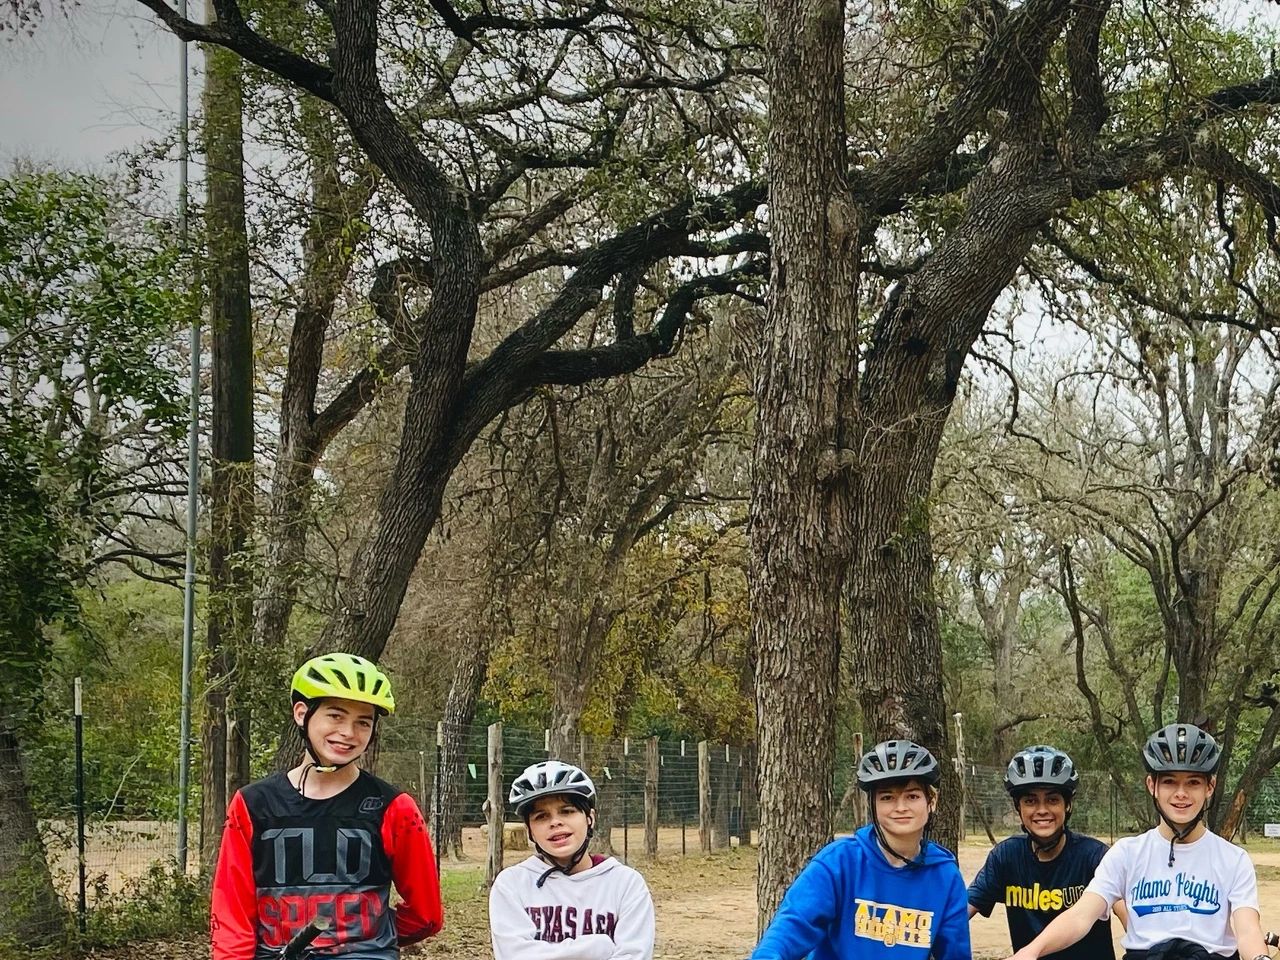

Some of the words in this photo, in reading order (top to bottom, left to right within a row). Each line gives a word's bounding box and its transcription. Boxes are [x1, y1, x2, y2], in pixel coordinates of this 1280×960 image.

[1131, 876, 1172, 905] Alamo
[1175, 872, 1219, 908] Heights
[525, 905, 577, 943] EXAS
